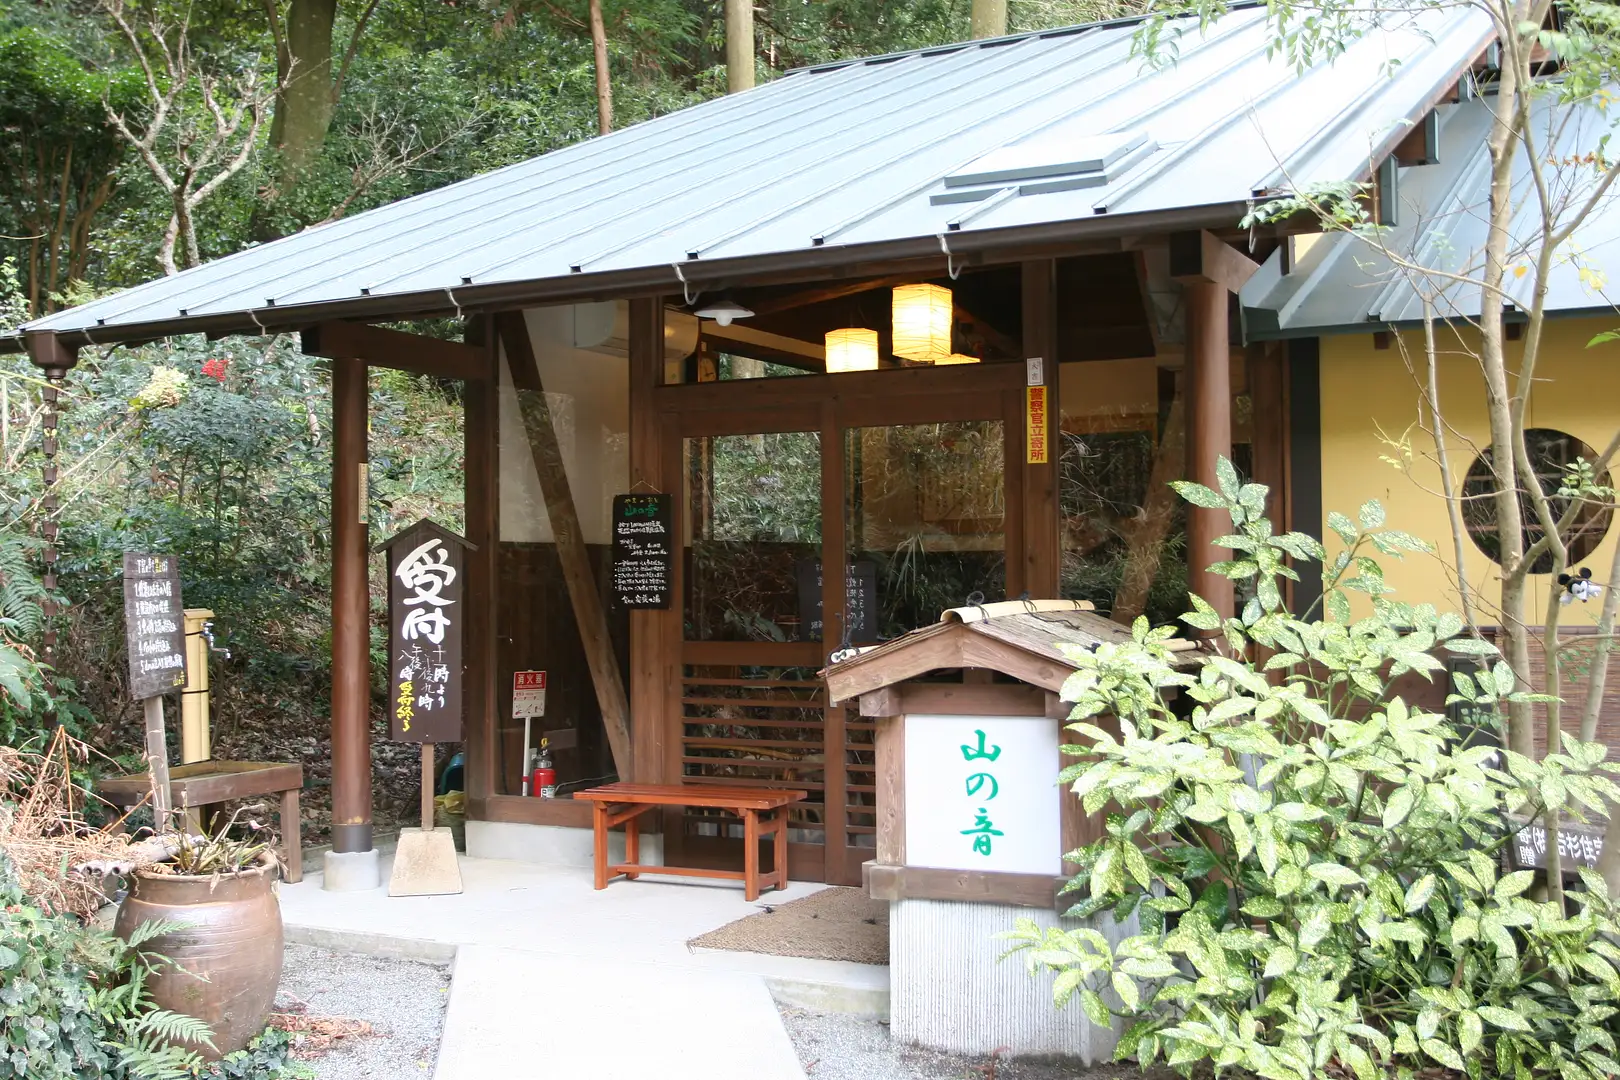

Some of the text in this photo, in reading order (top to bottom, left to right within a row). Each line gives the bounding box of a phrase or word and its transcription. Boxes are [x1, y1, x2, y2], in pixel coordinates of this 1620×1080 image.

[1030, 387, 1044, 461] 警察官立寄所
[395, 538, 457, 645] 受付
[517, 673, 542, 685] 消火器
[959, 729, 1005, 856] 山の音
